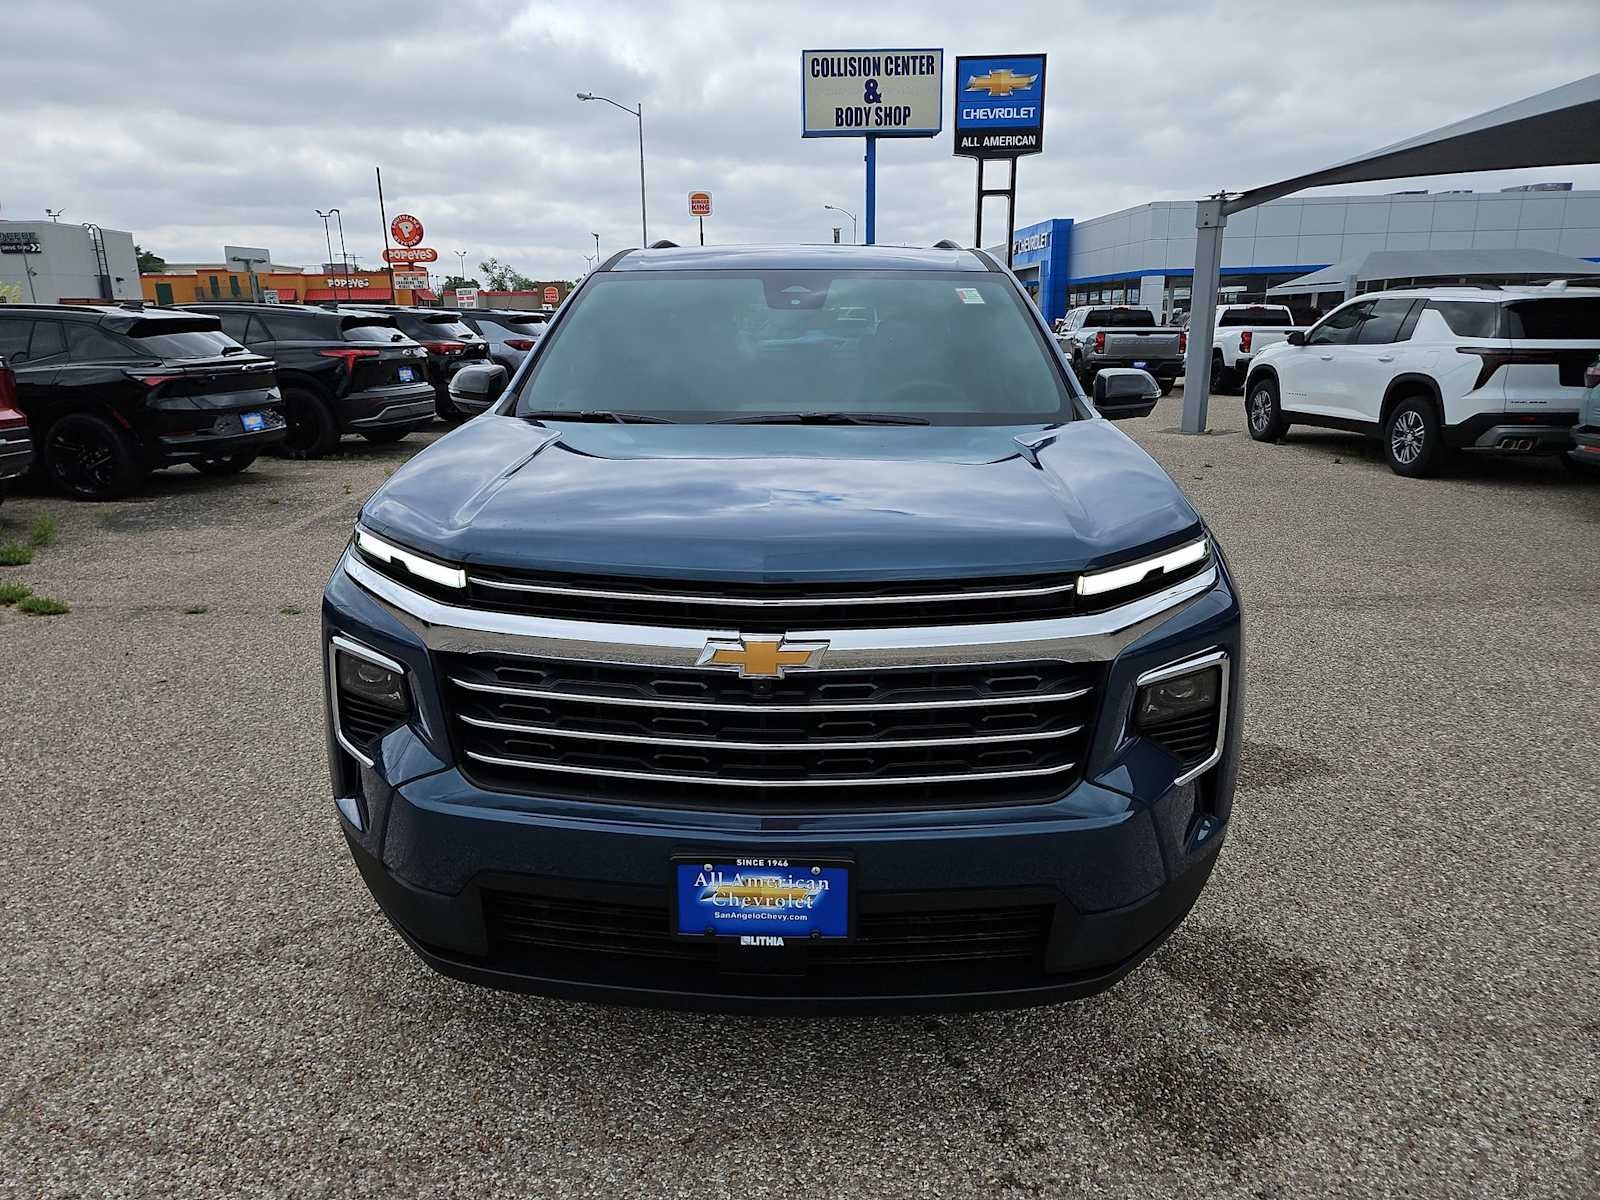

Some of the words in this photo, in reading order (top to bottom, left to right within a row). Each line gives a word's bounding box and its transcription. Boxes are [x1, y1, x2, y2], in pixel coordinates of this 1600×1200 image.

[811, 56, 880, 77] COLLISION
[884, 55, 935, 76] CENTER
[864, 78, 882, 104] &
[835, 107, 871, 127] BODY
[874, 106, 911, 126] SHOP
[962, 106, 1036, 120] CHEVROLET
[961, 136, 980, 147] ALL
[983, 135, 1036, 147] AMERICAN
[736, 859, 764, 867] SINCE
[767, 859, 789, 867] 1946
[693, 871, 723, 888] All
[733, 872, 830, 891] American
[711, 891, 814, 909] Chevrolet
[714, 911, 808, 922] SanAngeloChevy.com
[750, 936, 784, 947] LITHIA
